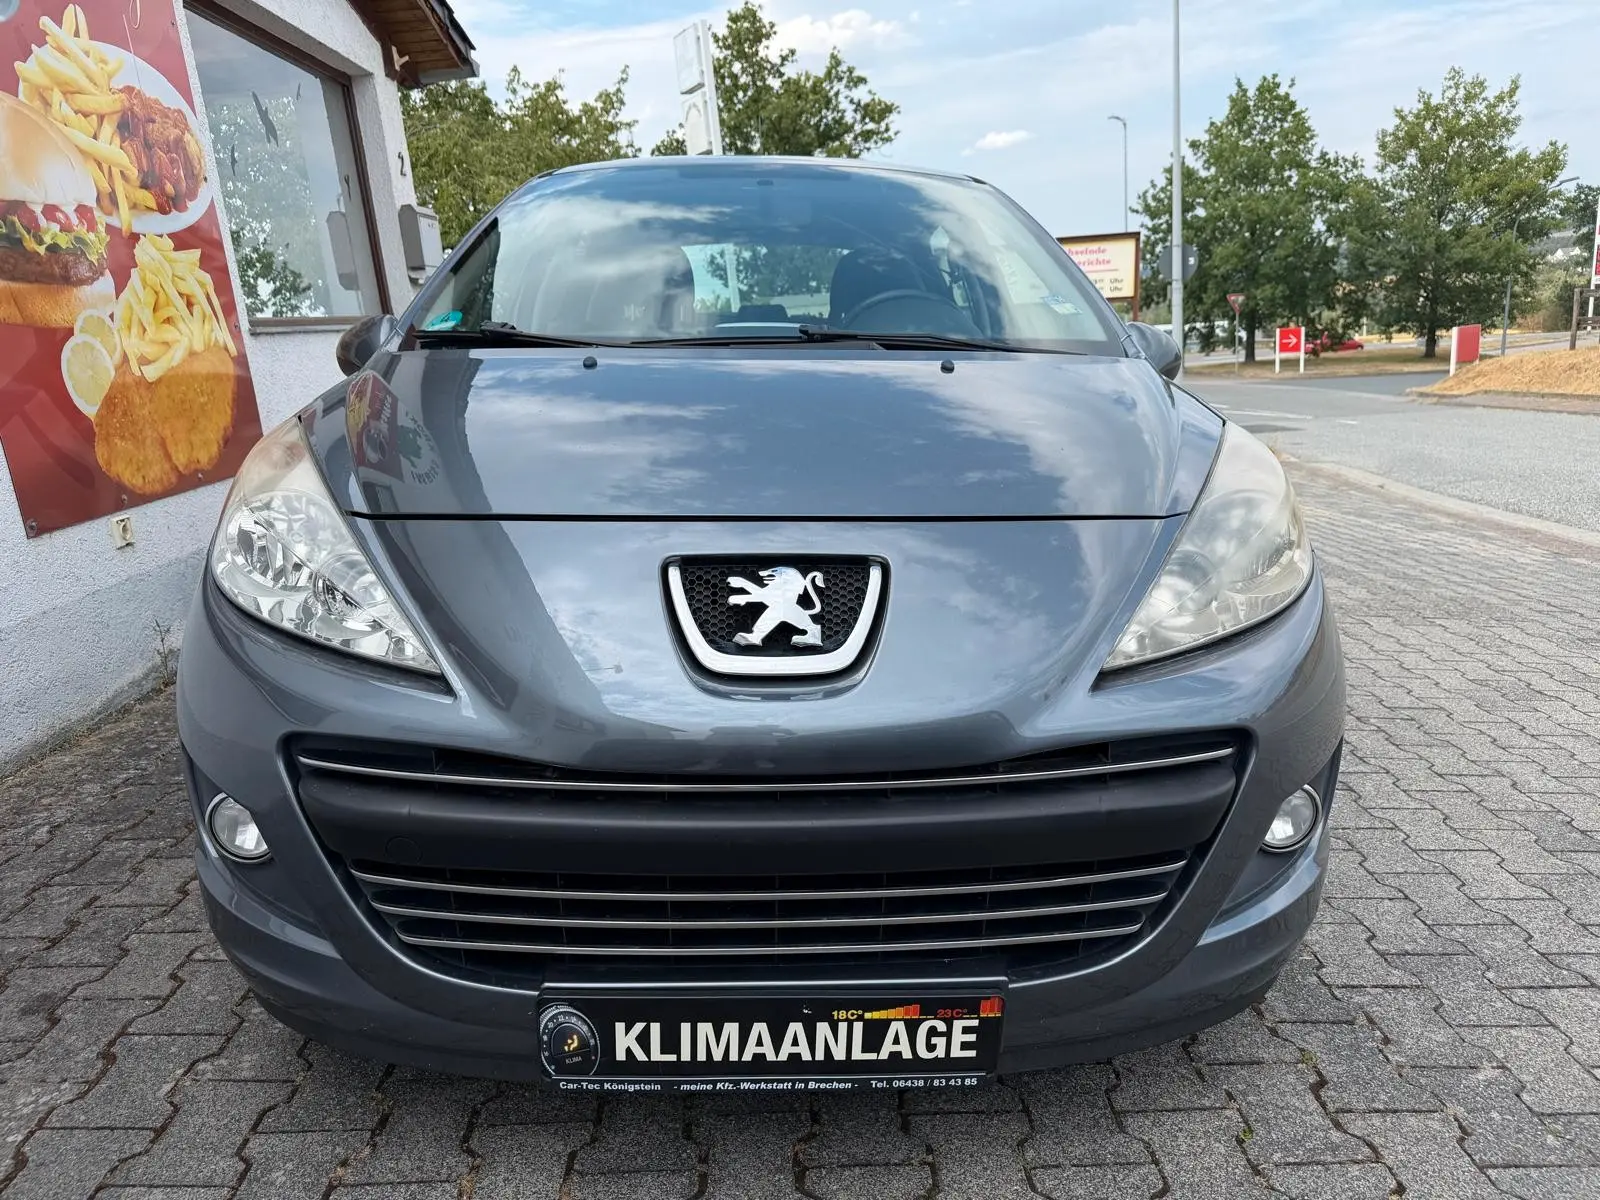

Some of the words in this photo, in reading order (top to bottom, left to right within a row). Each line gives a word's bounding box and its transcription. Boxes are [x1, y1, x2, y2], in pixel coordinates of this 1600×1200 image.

[614, 1019, 980, 1062] KLIMAANLAGE
[559, 1081, 601, 1090] Car-Tec
[603, 1082, 661, 1092] Königstein
[680, 1082, 713, 1091] meine
[716, 1081, 793, 1090] Kfz.-Werkstatt
[795, 1081, 805, 1090] in
[808, 1080, 852, 1090] Brechen
[870, 1080, 889, 1088] Tel.
[892, 1079, 924, 1088] 06438
[933, 1078, 946, 1087] 83
[949, 1078, 962, 1086] 43
[964, 1077, 978, 1086] 85
